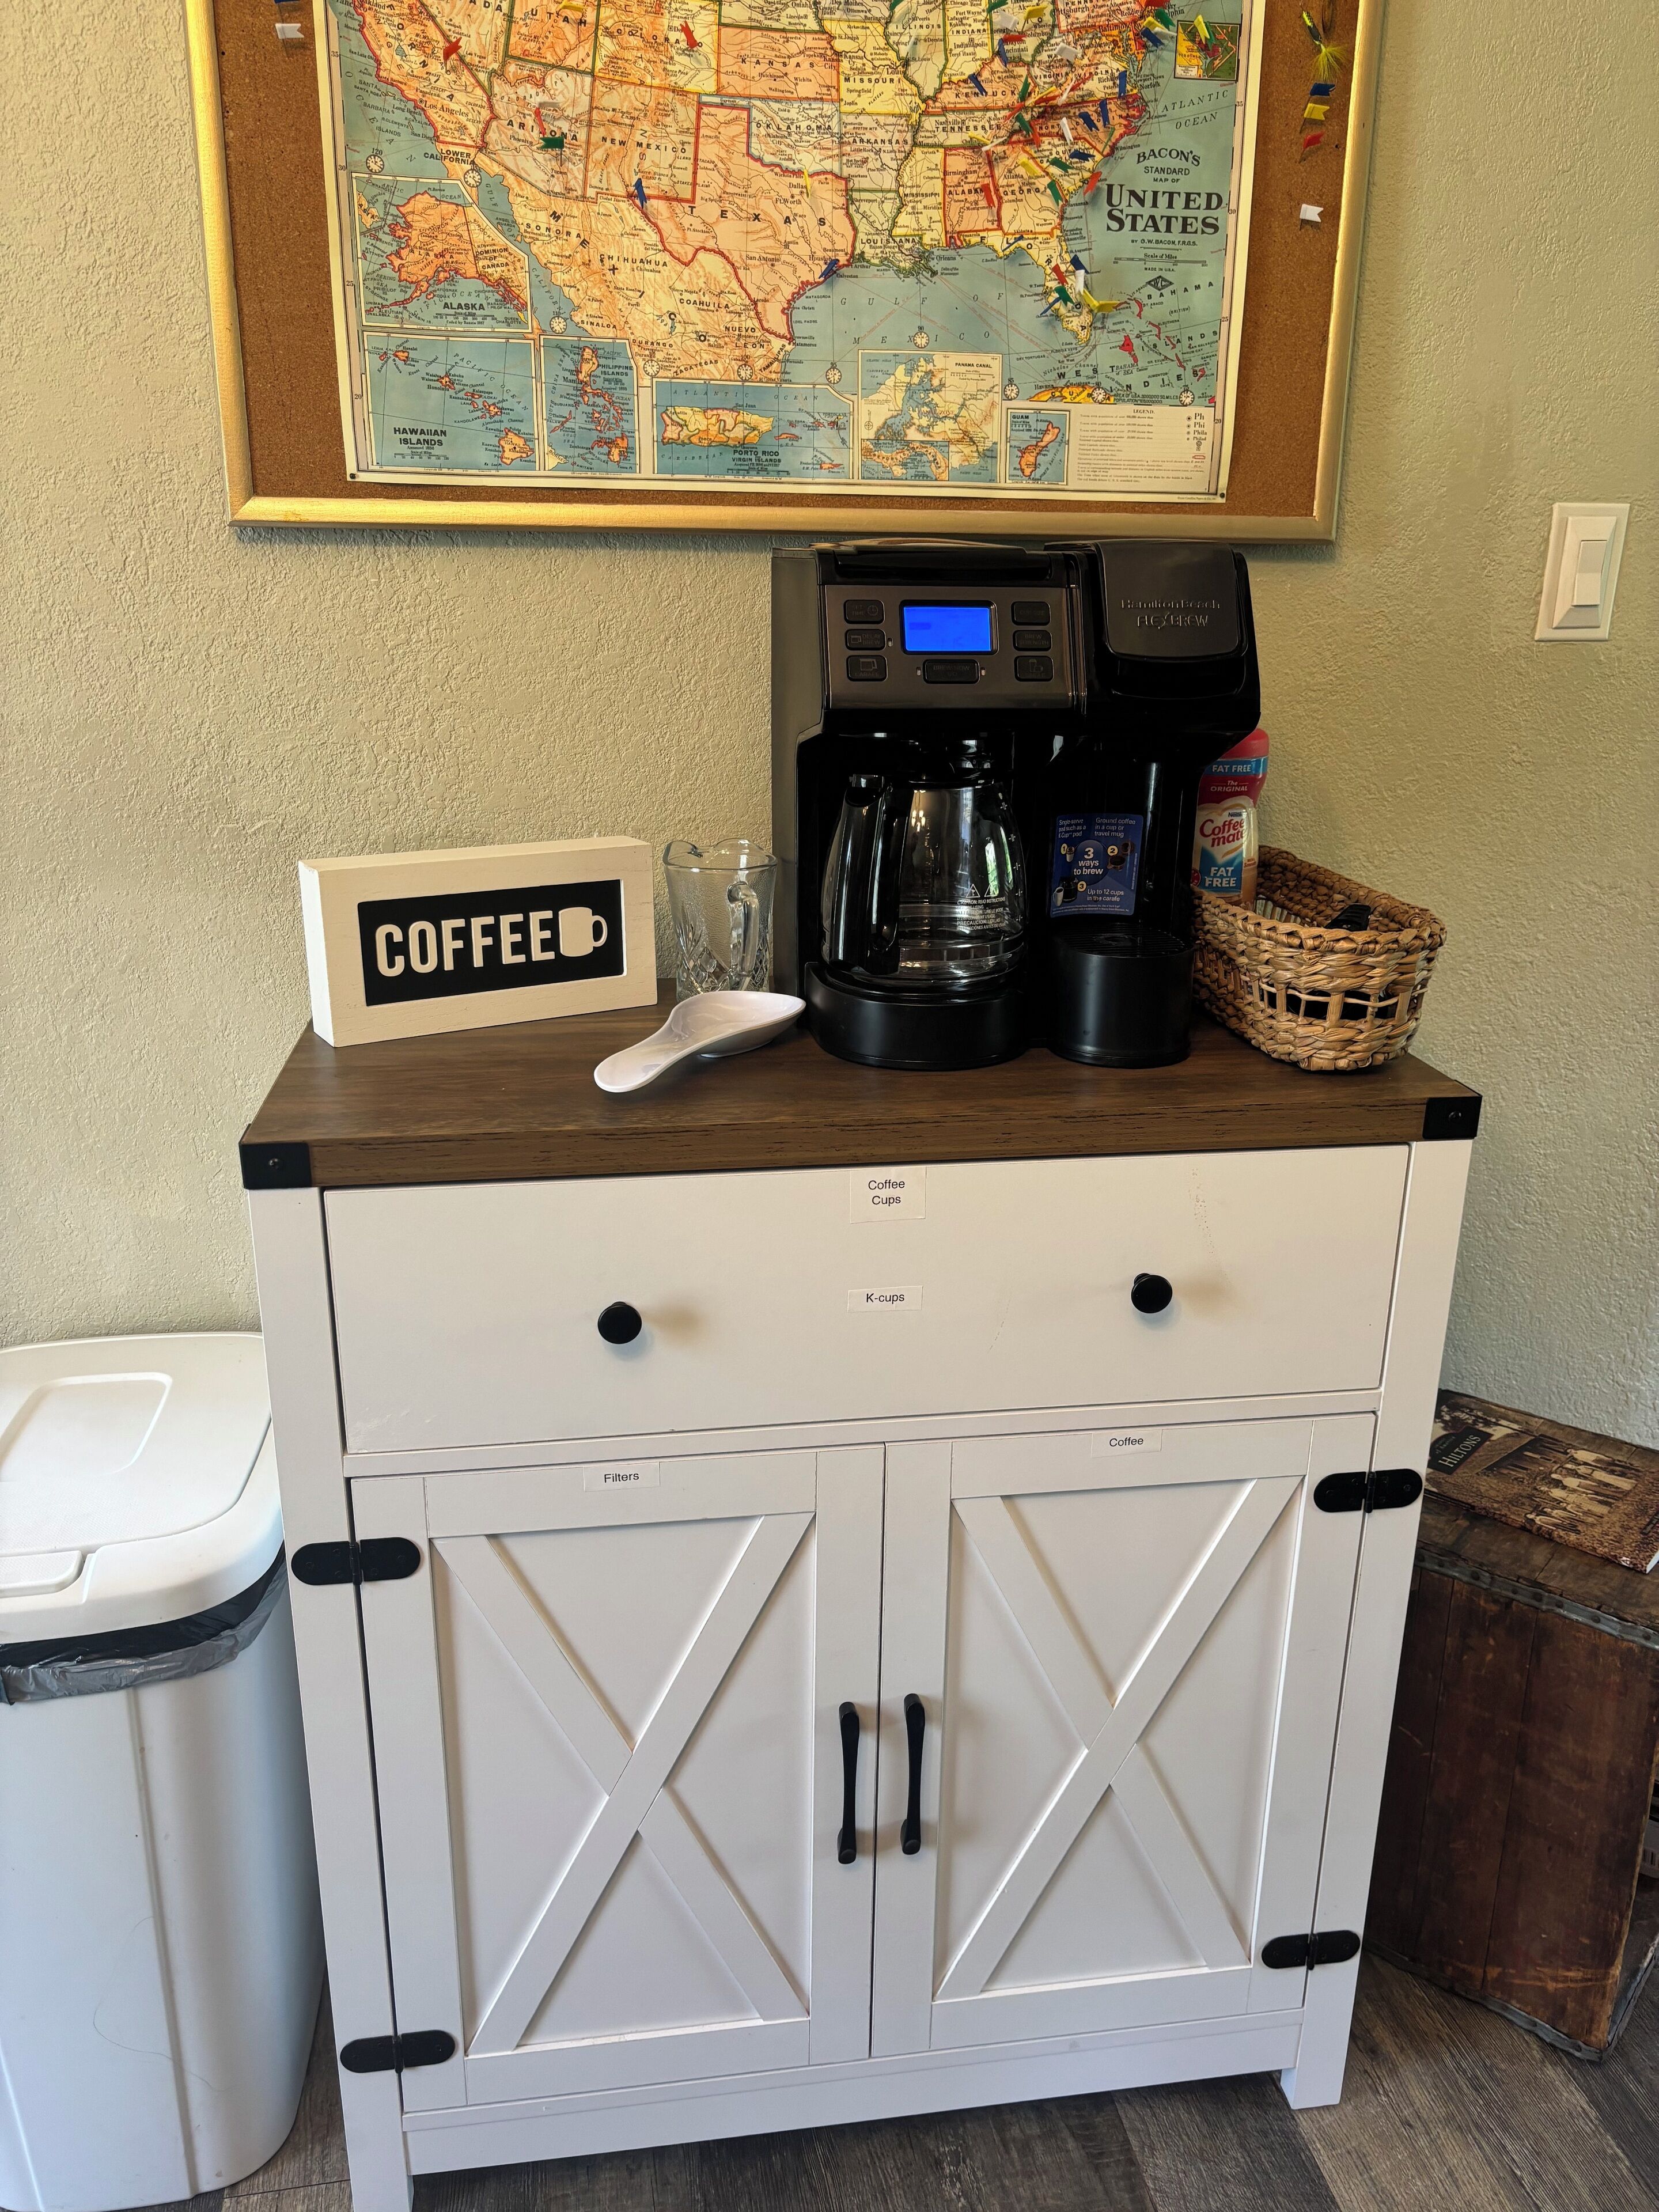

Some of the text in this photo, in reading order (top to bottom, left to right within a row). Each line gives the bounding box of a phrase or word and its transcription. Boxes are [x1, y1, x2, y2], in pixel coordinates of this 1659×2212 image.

[531, 8, 587, 27] UTAH
[741, 58, 815, 67] KANSAS
[359, 79, 377, 89] SANTA
[1161, 90, 1228, 113] ATLANTIC
[363, 102, 390, 114] BARBARA
[393, 104, 405, 113] Long
[439, 105, 469, 118] Angeles
[756, 122, 831, 131] OKLAHOMA
[1176, 112, 1218, 130] OCEAN
[376, 126, 402, 137] ISLANDS
[935, 124, 1001, 132] TENNESSEE
[602, 137, 686, 153] NEW MEXICO
[424, 152, 475, 165] CALIFORNIA
[441, 149, 471, 158] LOWER
[1137, 148, 1200, 166] BACON'S
[1144, 166, 1190, 176] STANDARD
[1106, 184, 1223, 211] UNITED
[688, 205, 826, 228] TEXAS
[1107, 209, 1219, 235] STATES
[526, 223, 581, 238] SONORA
[475, 247, 508, 256] DOMINION
[600, 253, 668, 267] CHIHUAHUA
[1147, 281, 1213, 300] BAHAMA
[679, 298, 730, 309] COAHUILA
[840, 293, 1003, 306] GULF OF
[443, 302, 486, 310] ALASKA
[581, 320, 617, 329] SINALOA
[632, 339, 673, 348] DURANGO
[853, 331, 990, 345] MEXICO
[759, 344, 786, 373] TAMAULIPAS
[453, 353, 495, 381] PACIFIC
[673, 360, 718, 376] ZACATECAS
[563, 377, 582, 385] Manila
[393, 427, 447, 437] HAWAIIAN
[399, 438, 444, 446] ISLANDS
[1122, 600, 1221, 609] Hamilton Beach
[1199, 818, 1245, 838] Coffee
[1211, 828, 1247, 848] mate
[1084, 847, 1094, 859] 3
[1210, 867, 1234, 877] FAT
[1205, 878, 1236, 887] FREE
[375, 910, 555, 978] COFFEE
[868, 1179, 905, 1190] Coffee
[872, 1195, 901, 1207] Cups
[866, 1293, 905, 1304] K-cups
[1108, 1434, 1144, 1448] Coffee
[1438, 1435, 1480, 1467] HILTONS
[603, 1469, 640, 1484] Filters
